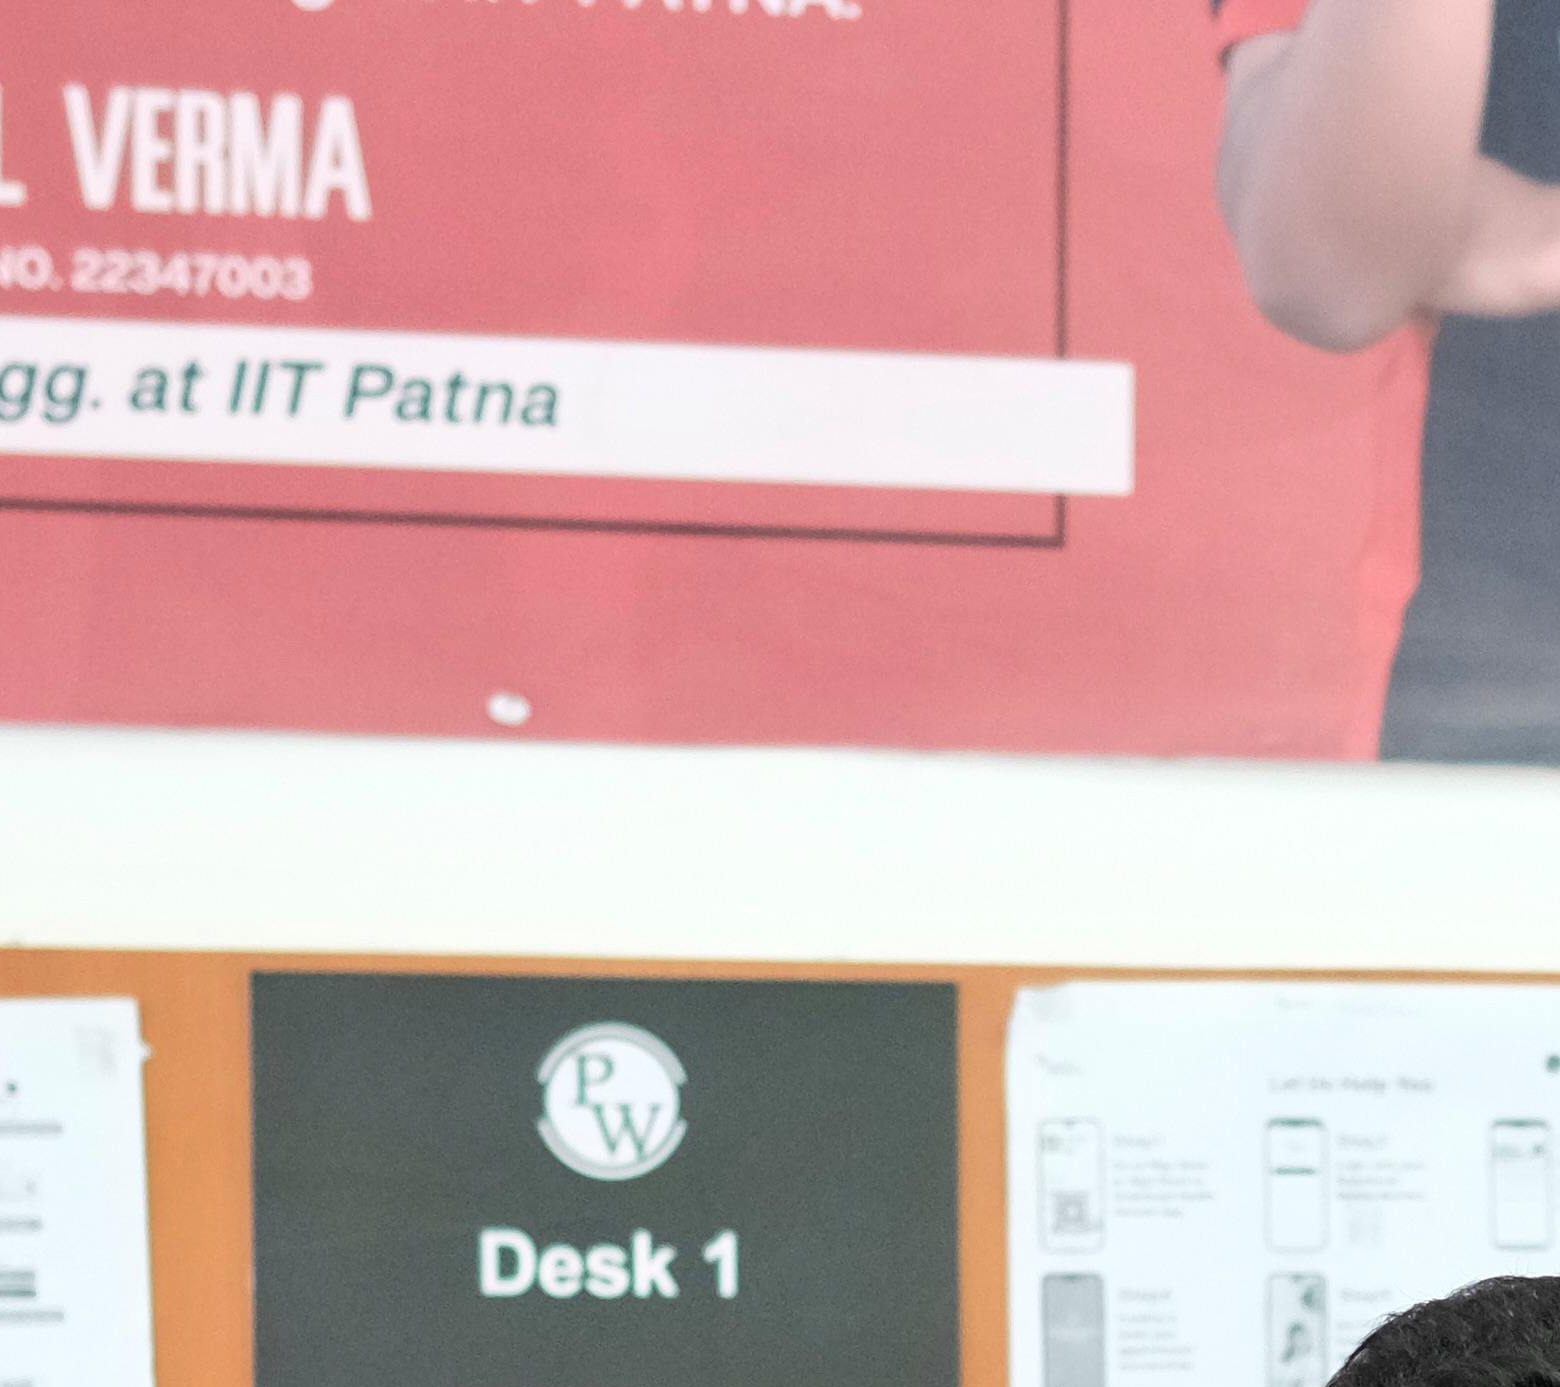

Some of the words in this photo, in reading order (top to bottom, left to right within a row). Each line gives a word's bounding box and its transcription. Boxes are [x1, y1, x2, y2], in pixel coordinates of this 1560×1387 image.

[62, 82, 373, 222] VERMA
[70, 247, 313, 301] 22347003
[128, 362, 202, 414] at
[228, 360, 324, 418] IIT
[344, 363, 561, 430] Patna
[574, 1053, 662, 1160] PW
[477, 1226, 679, 1299] Desk
[703, 1229, 740, 1299] 1
